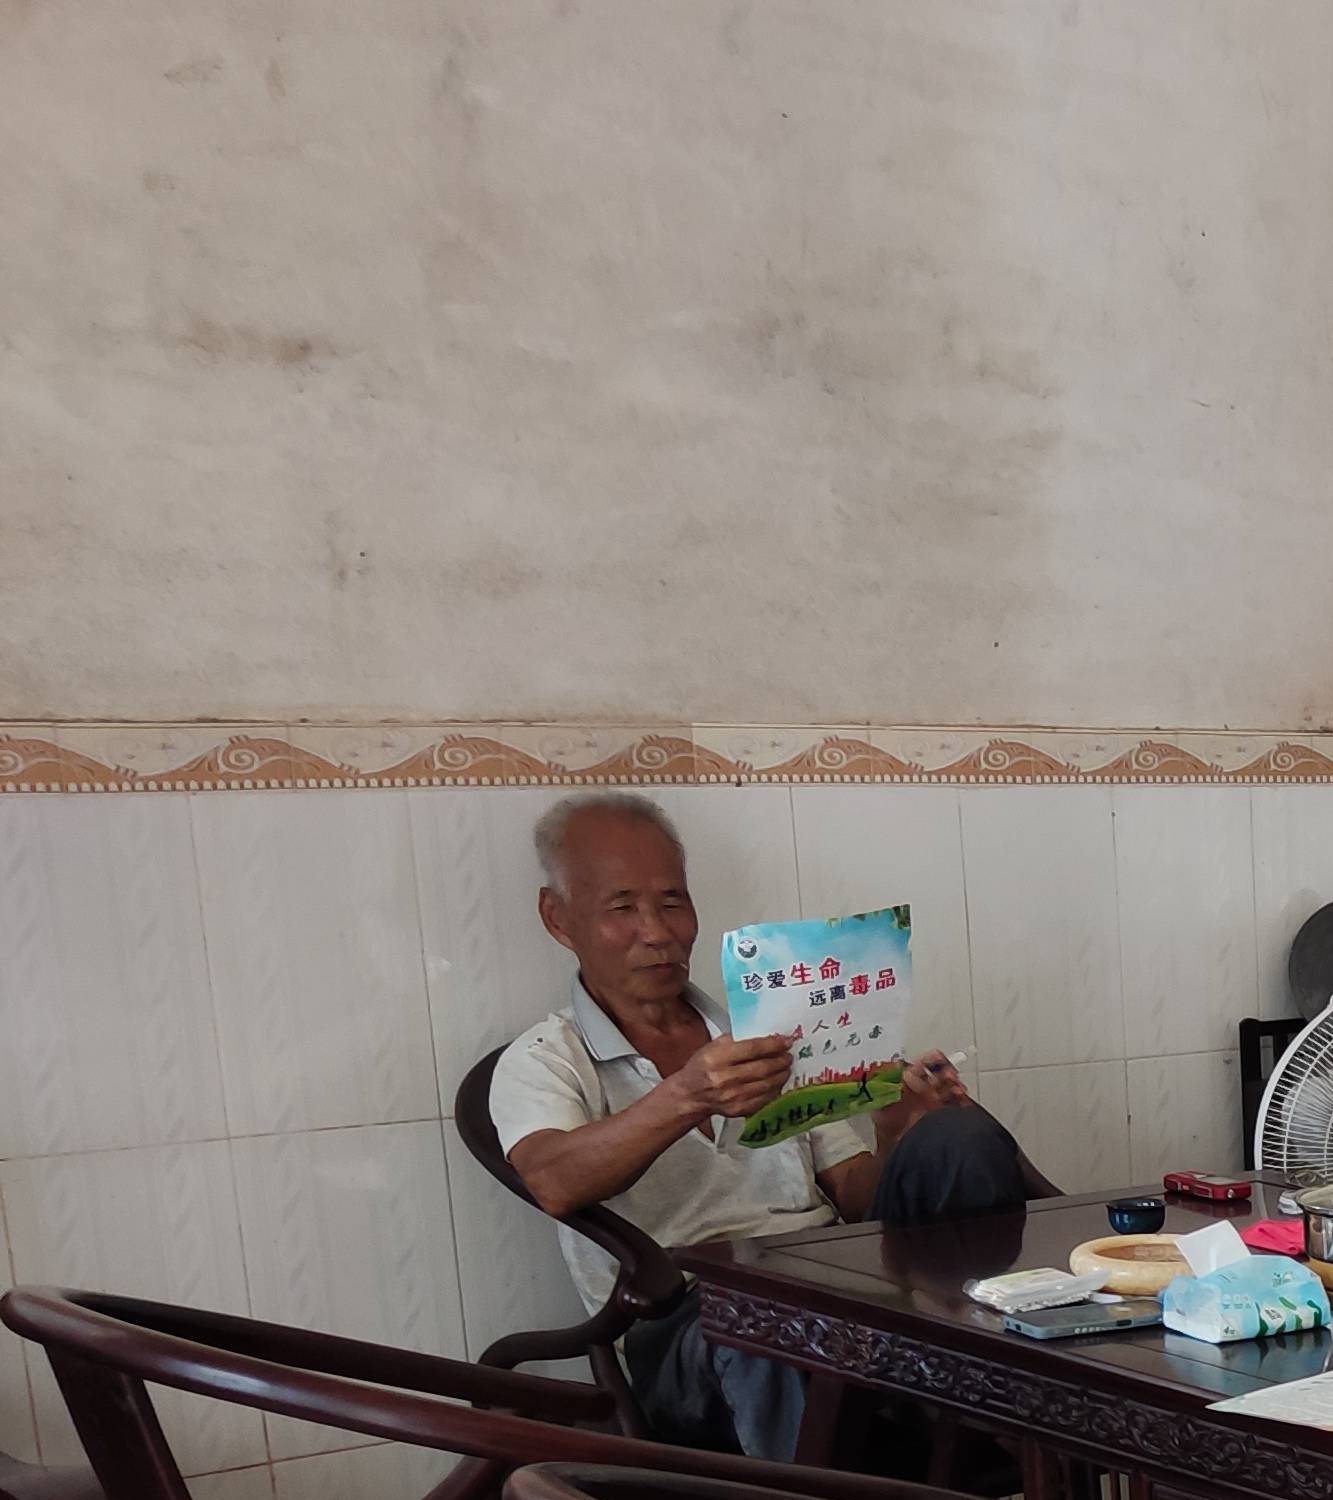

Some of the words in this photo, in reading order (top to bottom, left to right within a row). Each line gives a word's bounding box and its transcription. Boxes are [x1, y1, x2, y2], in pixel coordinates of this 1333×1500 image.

[742, 957, 841, 992] 珍爱生命
[808, 967, 897, 1008] 远离毒品
